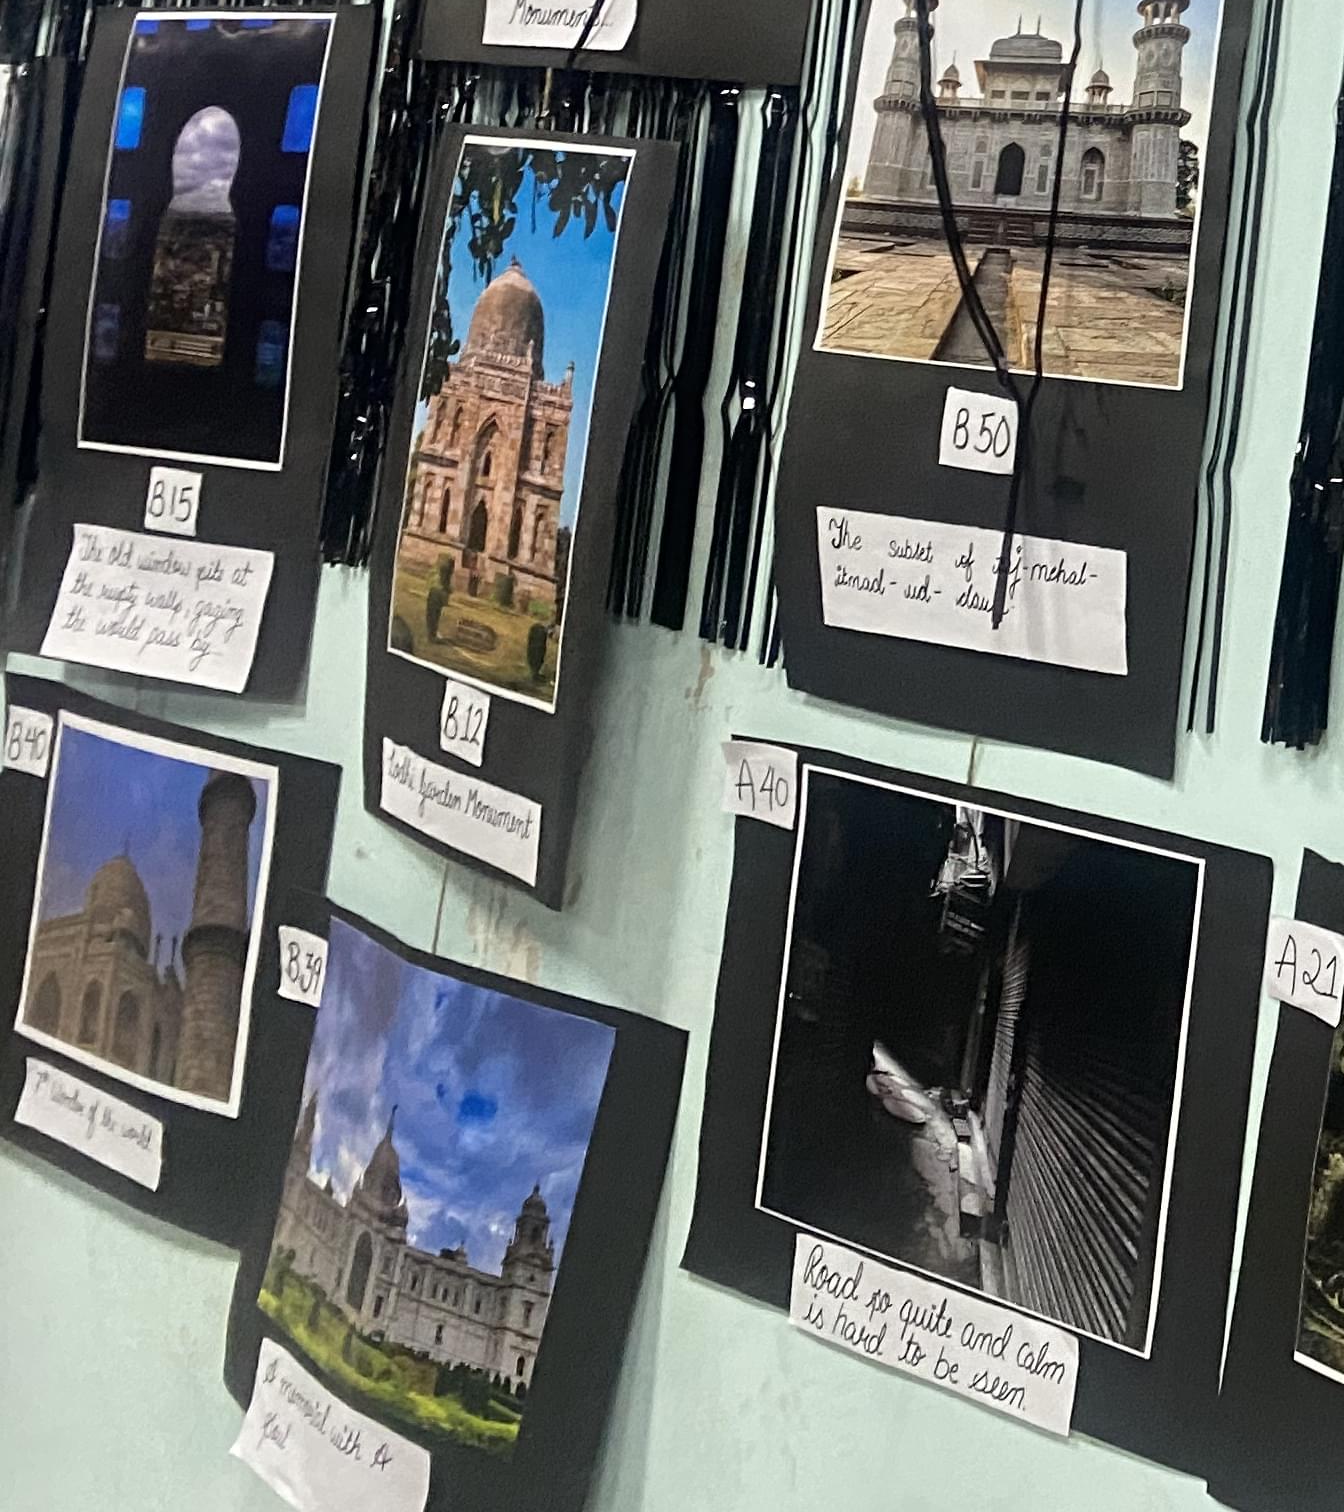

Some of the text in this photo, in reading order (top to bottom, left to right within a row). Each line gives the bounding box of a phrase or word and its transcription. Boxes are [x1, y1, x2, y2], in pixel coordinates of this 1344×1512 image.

[953, 408, 1010, 458] B50
[148, 480, 193, 523] B15
[231, 560, 255, 586] at
[828, 516, 975, 582] The of
[69, 572, 93, 597] the
[61, 605, 86, 632] the
[443, 696, 484, 746] B12
[734, 758, 788, 812] A40
[1275, 934, 1338, 999] A21
[803, 1244, 1066, 1385] Road so and calm
[802, 1293, 1027, 1412] is hard to be seen.
